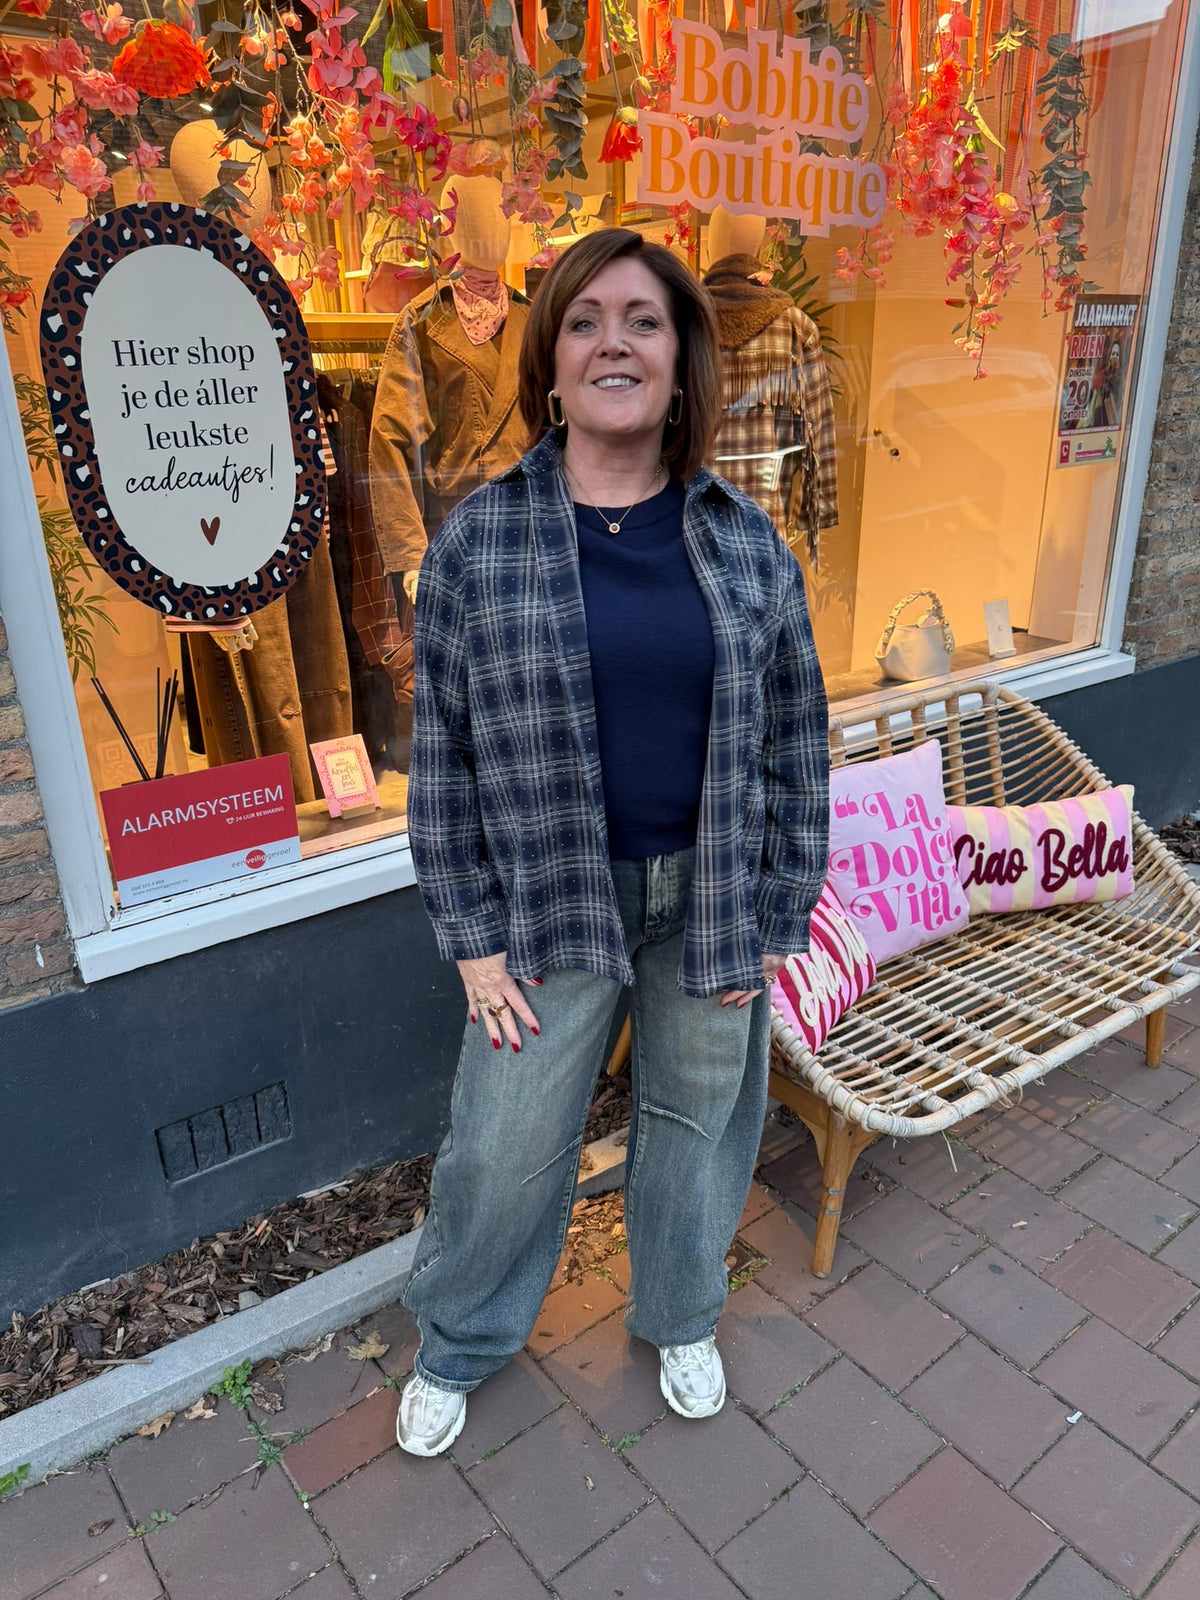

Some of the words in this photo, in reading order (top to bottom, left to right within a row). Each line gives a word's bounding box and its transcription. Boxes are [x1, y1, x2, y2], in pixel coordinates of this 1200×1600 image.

[679, 31, 863, 132] Bobbie
[646, 123, 881, 227] Boutique
[1075, 304, 1138, 328] JAARMARKT
[111, 339, 179, 367] Hier
[187, 336, 255, 371] shop
[1069, 334, 1105, 359] RIJEN
[1069, 367, 1094, 378] DINSDAG
[120, 383, 147, 419] je
[155, 380, 189, 407] de
[196, 378, 259, 406] áller
[1062, 409, 1088, 421] OKTOBER
[144, 420, 250, 451] leukste
[125, 443, 275, 503] cadeautjes!
[121, 784, 284, 837] ALARMSYSTEEM
[256, 806, 285, 817] BEWAKING
[953, 833, 1028, 891] Ciao
[1037, 821, 1130, 893] Bella
[850, 880, 961, 933] Vita
